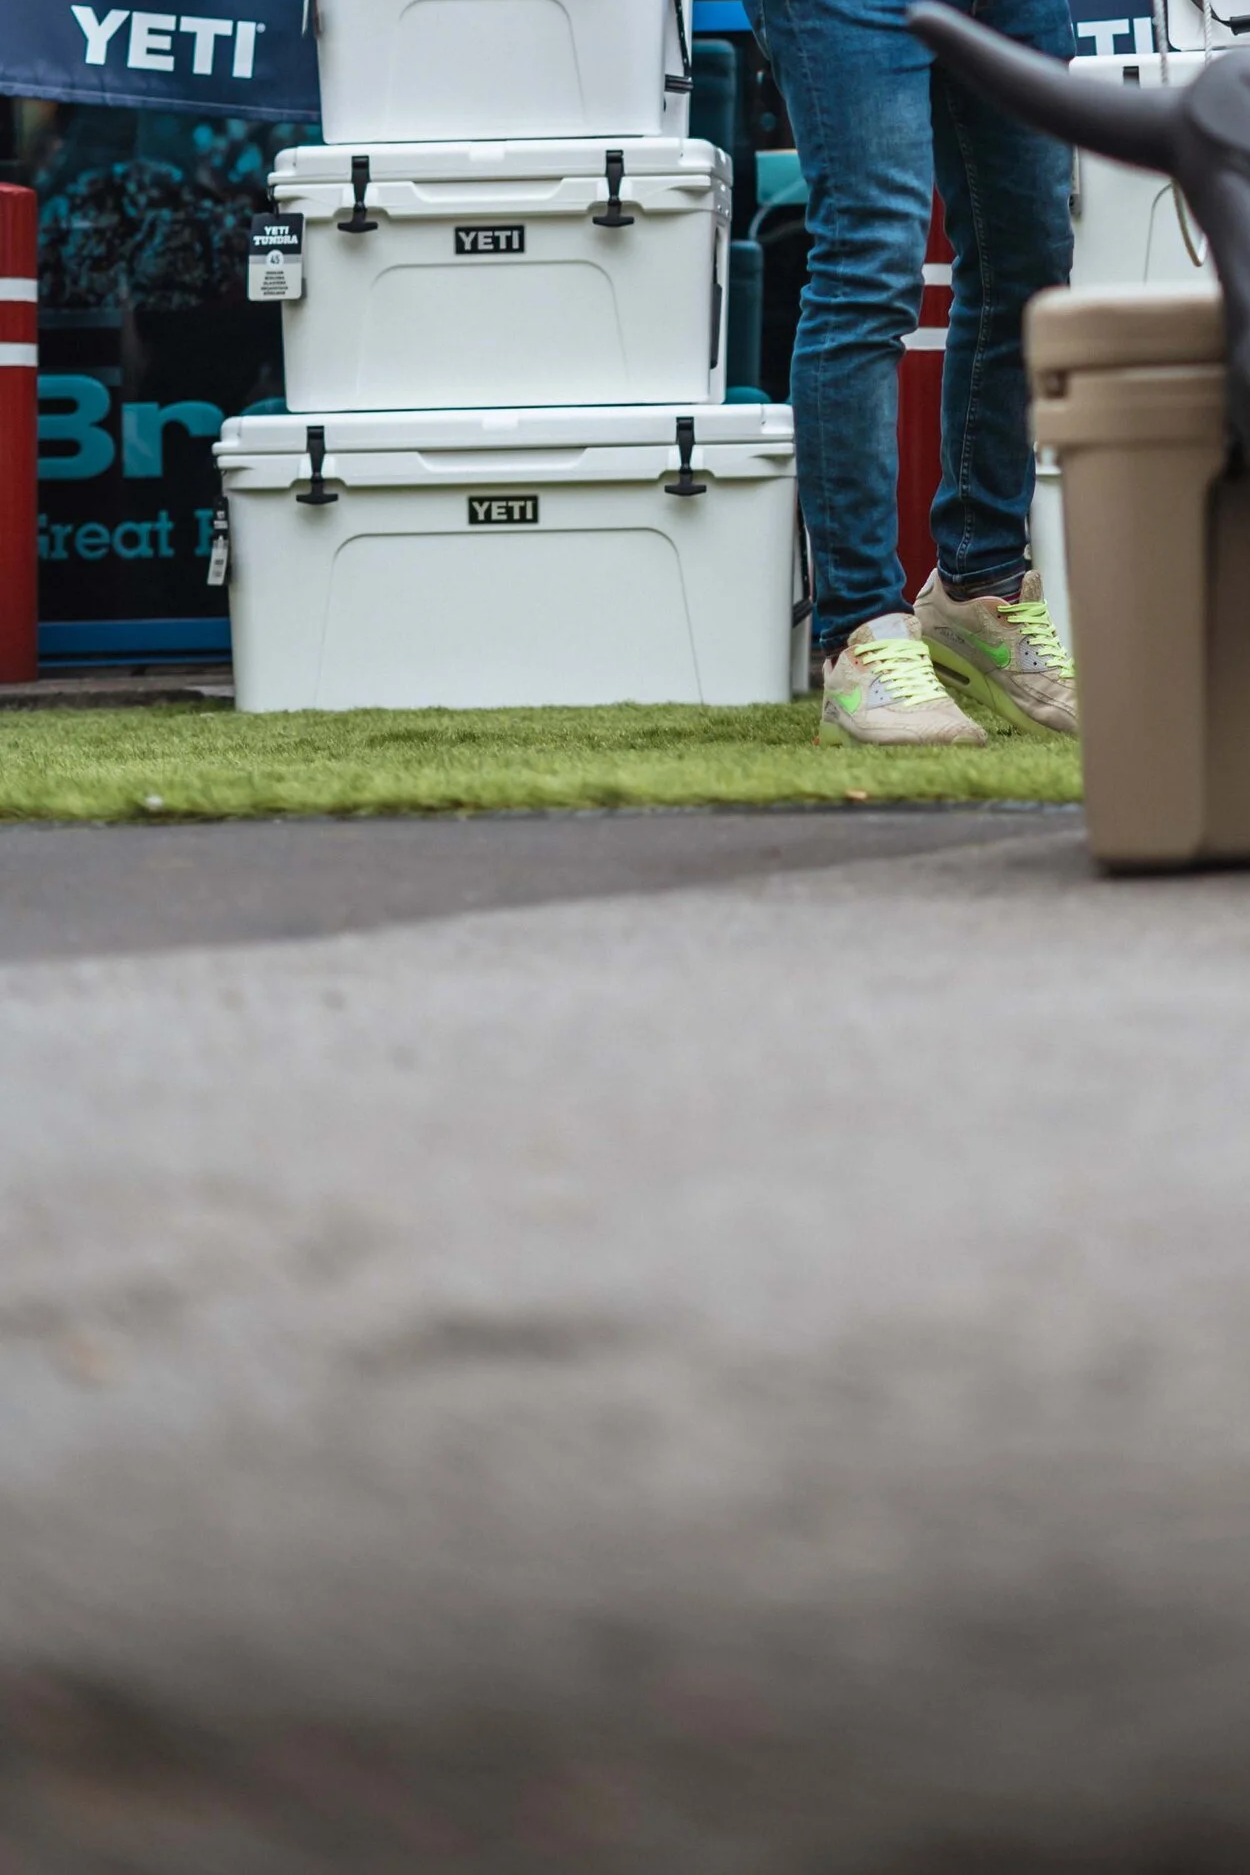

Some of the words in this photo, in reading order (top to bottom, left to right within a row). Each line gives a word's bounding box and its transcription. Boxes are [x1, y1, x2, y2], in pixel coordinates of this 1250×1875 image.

[71, 5, 257, 79] YETI
[253, 235, 298, 246] TUNDRA
[264, 226, 290, 236] YETI
[457, 229, 520, 251] YETI
[471, 499, 534, 521] YETI
[37, 509, 175, 560] reat
